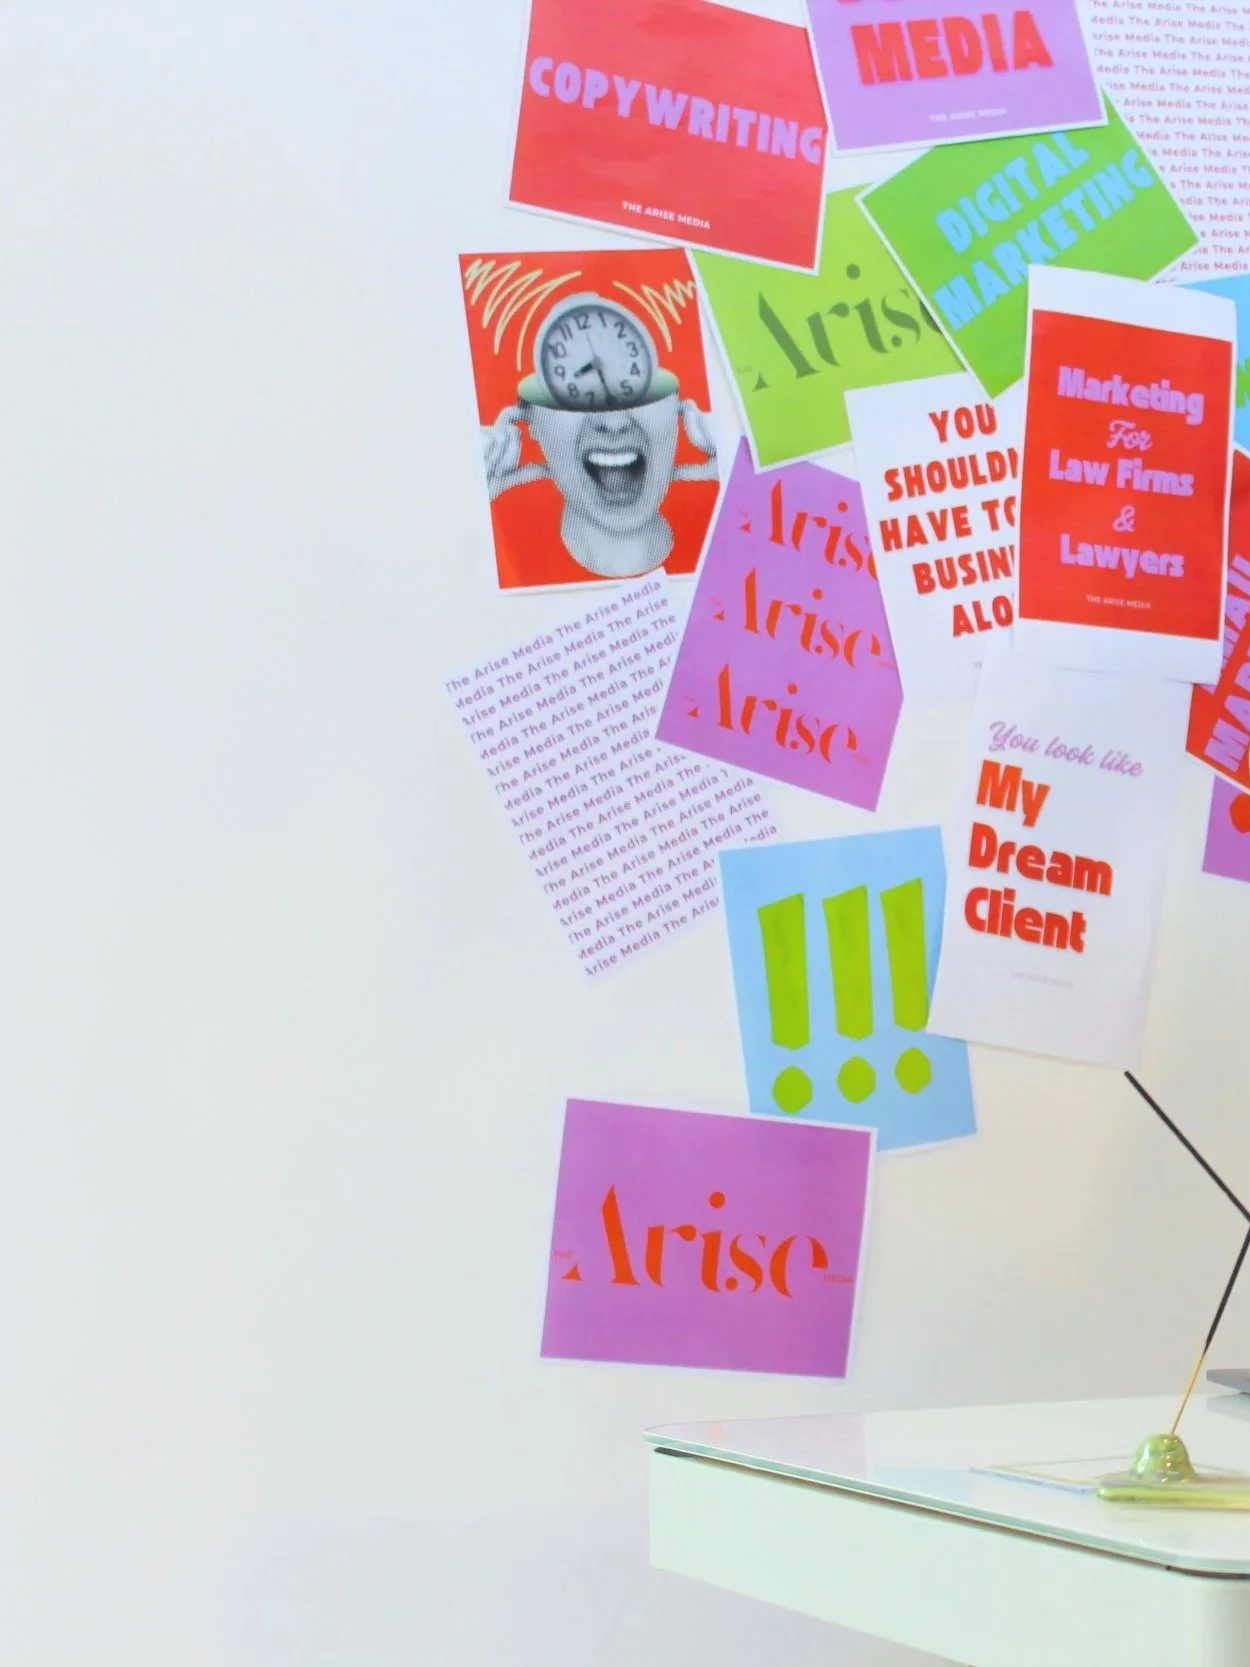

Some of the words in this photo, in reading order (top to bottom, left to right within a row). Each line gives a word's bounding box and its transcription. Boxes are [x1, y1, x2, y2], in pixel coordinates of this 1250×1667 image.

[1129, 16, 1150, 26] The
[1154, 18, 1183, 28] Arise
[1187, 20, 1221, 29] Media
[1225, 21, 1245, 31] The
[850, 10, 1053, 84] MEDIA
[1118, 49, 1148, 58] Arise
[1152, 50, 1186, 60] Media
[1190, 51, 1210, 61] The
[1215, 52, 1244, 62] Arise
[529, 56, 826, 164] COPYWRITING
[1123, 98, 1153, 107] Arise
[1156, 99, 1192, 108] Media
[1195, 100, 1216, 109] The
[1220, 101, 1249, 110] Arise
[1129, 82, 1165, 91] Media
[1169, 82, 1190, 93] The
[1194, 84, 1223, 94] Arise
[1162, 147, 1197, 157] Media
[1201, 148, 1222, 158] The
[1170, 162, 1199, 172] Arise
[1203, 164, 1237, 174] Media
[622, 200, 641, 213] THE
[643, 206, 674, 220] ARISE
[676, 213, 711, 229] MEDIA
[935, 130, 1089, 255] DIGITAL
[1207, 196, 1228, 205] The
[931, 147, 1155, 331] MARKETING
[1209, 212, 1243, 222] Media
[1211, 228, 1240, 238] Arise
[1180, 260, 1210, 270] Arise
[1213, 261, 1248, 270] Media
[561, 323, 574, 340] 11
[573, 315, 591, 331] 12
[597, 312, 607, 328] 1
[614, 321, 627, 338] 2
[550, 343, 567, 359] 10
[626, 341, 638, 358] 3
[629, 363, 641, 377] 4
[554, 367, 565, 381] 9
[568, 382, 580, 398] 8
[619, 380, 633, 397] 5
[1057, 366, 1205, 425] Marketing
[929, 402, 997, 443] YOU
[1106, 419, 1153, 451] For
[1049, 449, 1110, 486] Law
[1116, 459, 1194, 496] Firms
[879, 505, 972, 552] HAVE
[1112, 505, 1136, 532] &
[1060, 534, 1184, 578] Lawyers
[712, 567, 882, 669] Arise
[1086, 594, 1101, 604] THE
[1103, 597, 1125, 607] ARISE
[1126, 600, 1152, 610] MEDIA
[474, 657, 510, 680] Arise
[511, 635, 554, 660] Media
[554, 620, 582, 638] The
[585, 603, 619, 624] Arise
[620, 581, 661, 606] Media
[496, 670, 523, 688] The
[527, 652, 561, 675] Arise
[563, 629, 605, 656] Media
[606, 616, 632, 633] The
[636, 597, 668, 620] Arise
[498, 682, 541, 709] Media
[542, 668, 569, 686] The
[572, 649, 607, 672] Arise
[608, 628, 650, 654] Media
[650, 614, 676, 631] The
[498, 707, 534, 732] Arise
[535, 685, 577, 711] Media
[578, 671, 605, 688] The
[608, 652, 642, 675] Arise
[685, 661, 858, 763] Arise
[523, 732, 565, 759] Media
[566, 719, 592, 736] The
[596, 699, 629, 723] Arise
[989, 721, 1041, 753] You
[1045, 735, 1094, 767] look
[1098, 748, 1145, 778] like
[544, 771, 571, 788] The
[574, 752, 608, 776] Arise
[610, 728, 650, 756] Media
[546, 782, 588, 810] Media
[589, 768, 615, 786] The
[619, 748, 652, 773] Arise
[567, 821, 594, 838] The
[598, 801, 632, 824] Arise
[633, 778, 675, 805] Media
[675, 764, 702, 781] The
[976, 759, 1051, 828] My
[570, 832, 612, 859] Media
[612, 817, 639, 835] The
[643, 797, 677, 822] Arise
[678, 775, 719, 801] Media
[570, 857, 604, 881] Arise
[606, 834, 648, 860] Media
[648, 819, 676, 836] The
[679, 799, 712, 824] Arise
[714, 777, 754, 803] Media
[591, 870, 618, 888] The
[622, 850, 656, 874] Arise
[657, 827, 699, 854] Media
[699, 812, 725, 830] The
[729, 793, 761, 816] Arise
[594, 882, 637, 908] Media
[637, 867, 664, 884] The
[667, 846, 700, 871] Arise
[702, 823, 743, 850] Media
[744, 809, 769, 826] The
[968, 821, 1115, 897] Dream
[619, 930, 661, 958] Media
[661, 915, 687, 933] The
[964, 886, 1088, 954] Client
[560, 1184, 829, 1298] Arise
